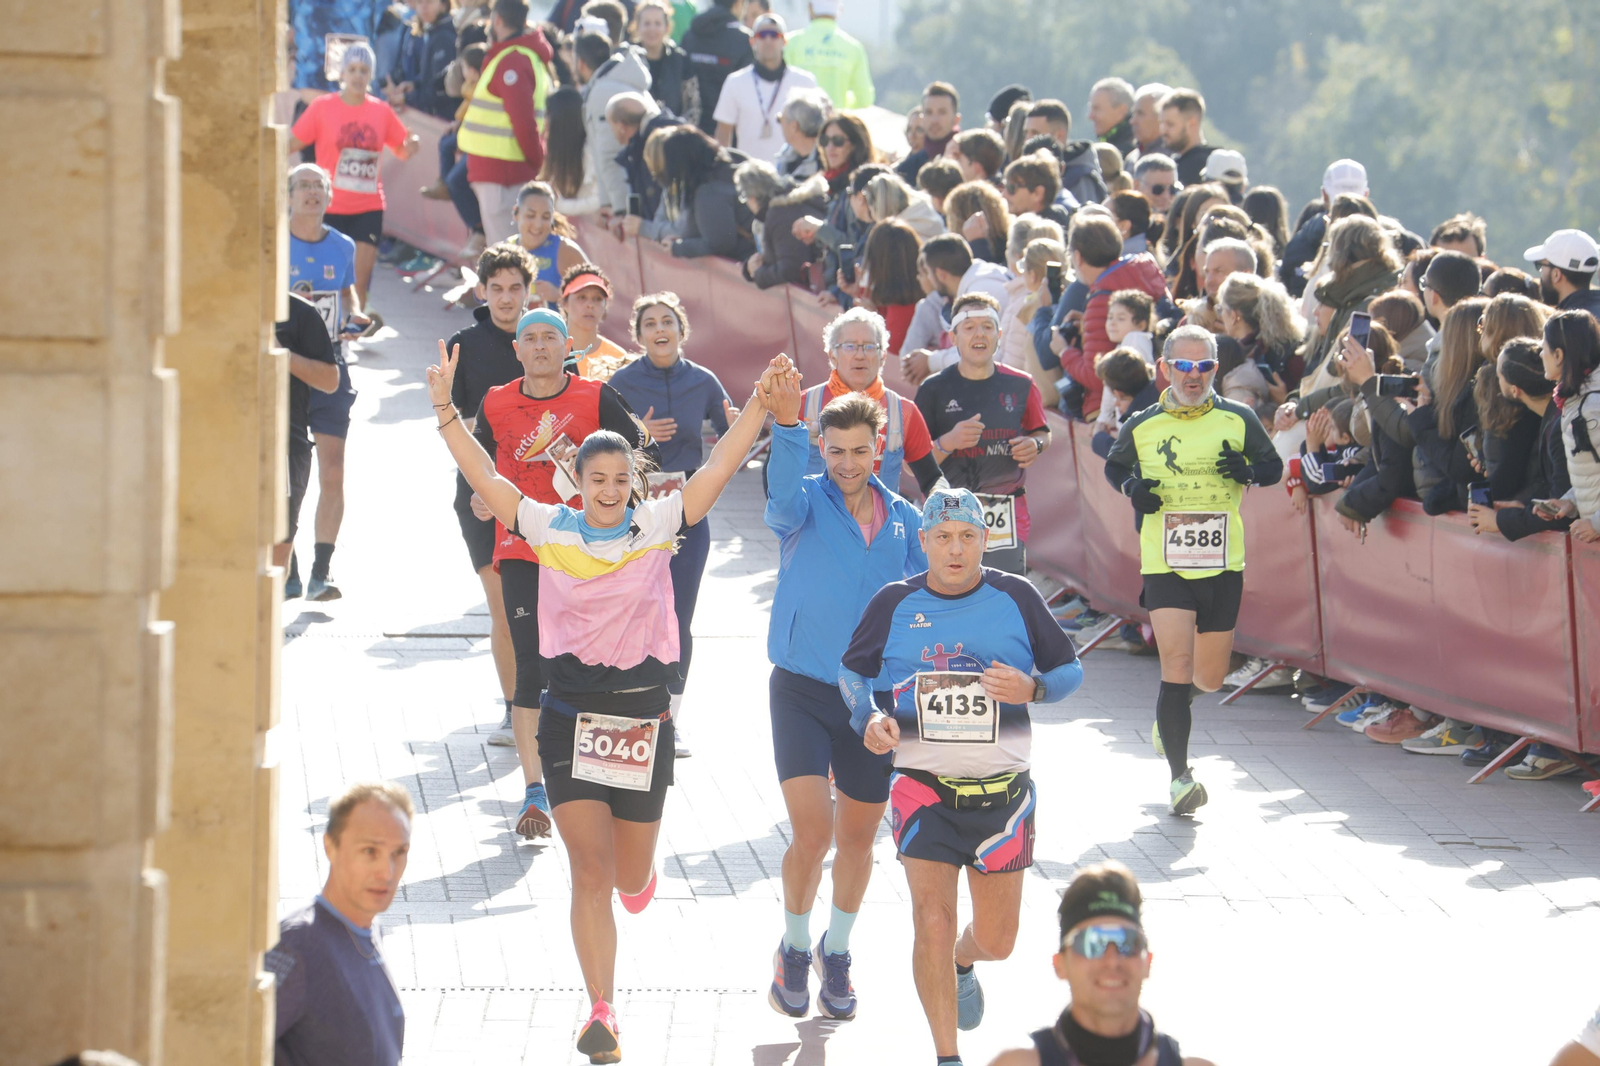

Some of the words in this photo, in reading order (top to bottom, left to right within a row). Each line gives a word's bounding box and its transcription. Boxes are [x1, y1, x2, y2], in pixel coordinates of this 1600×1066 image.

[1168, 529, 1223, 548] 4588
[909, 621, 932, 629] VIATOR
[927, 693, 988, 716] 4135
[578, 731, 650, 762] 5040
